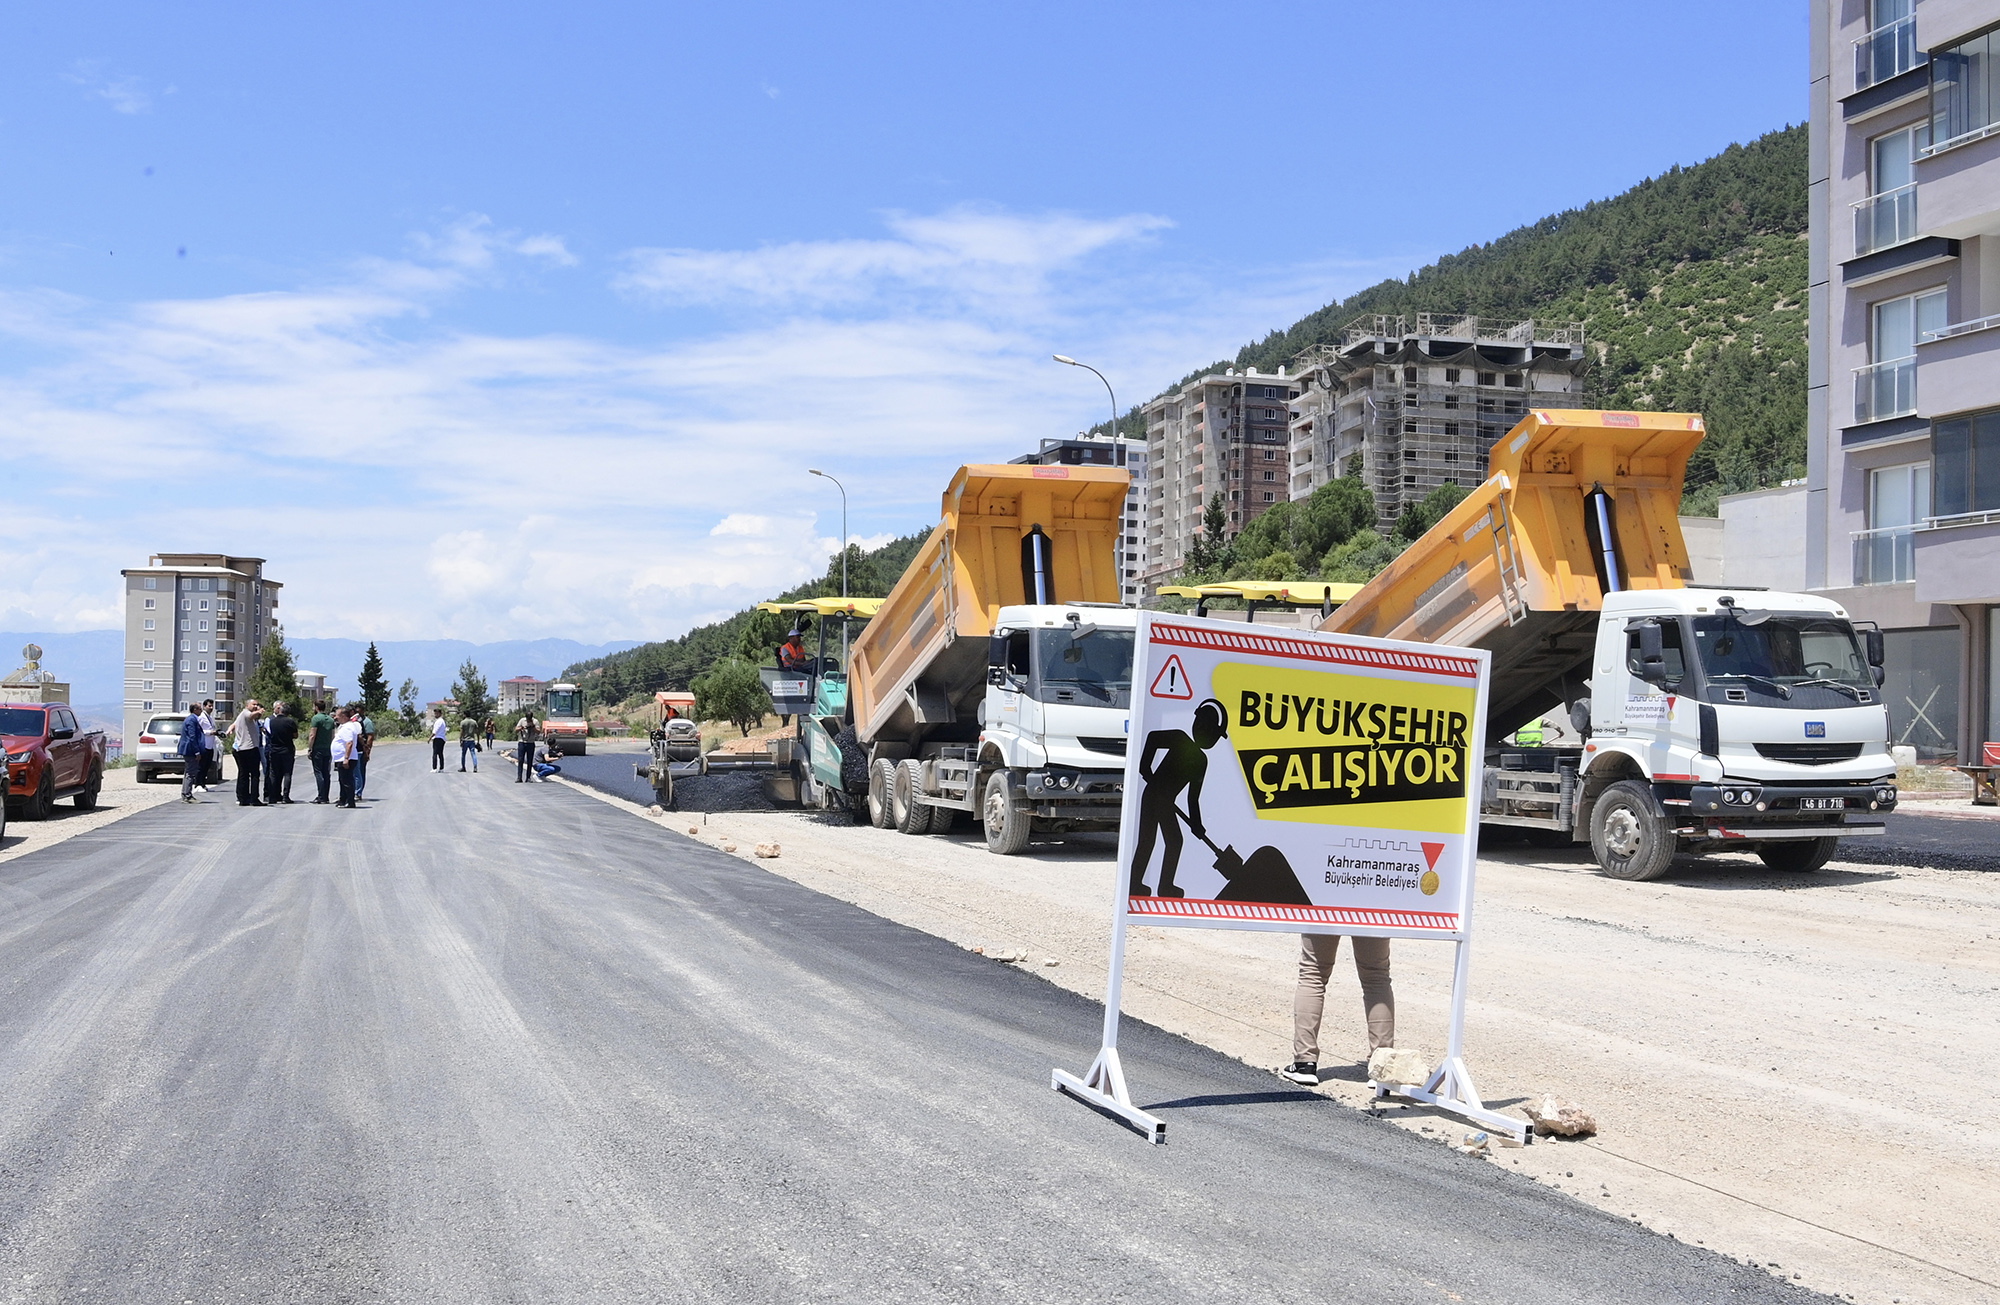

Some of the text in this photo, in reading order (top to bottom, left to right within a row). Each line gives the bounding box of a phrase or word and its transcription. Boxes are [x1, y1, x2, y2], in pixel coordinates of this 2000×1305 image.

[1625, 705, 1665, 713] Kahramanmaraş
[1239, 690, 1468, 750] BÜYÜKŞEHİR
[1252, 748, 1459, 803] ÇALIŞIYOR
[1805, 799, 1815, 809] 46
[1830, 799, 1843, 808] 710
[1327, 855, 1420, 876] Kahramanmaraş
[1325, 871, 1419, 891] Büyükşehir Belediyesi
